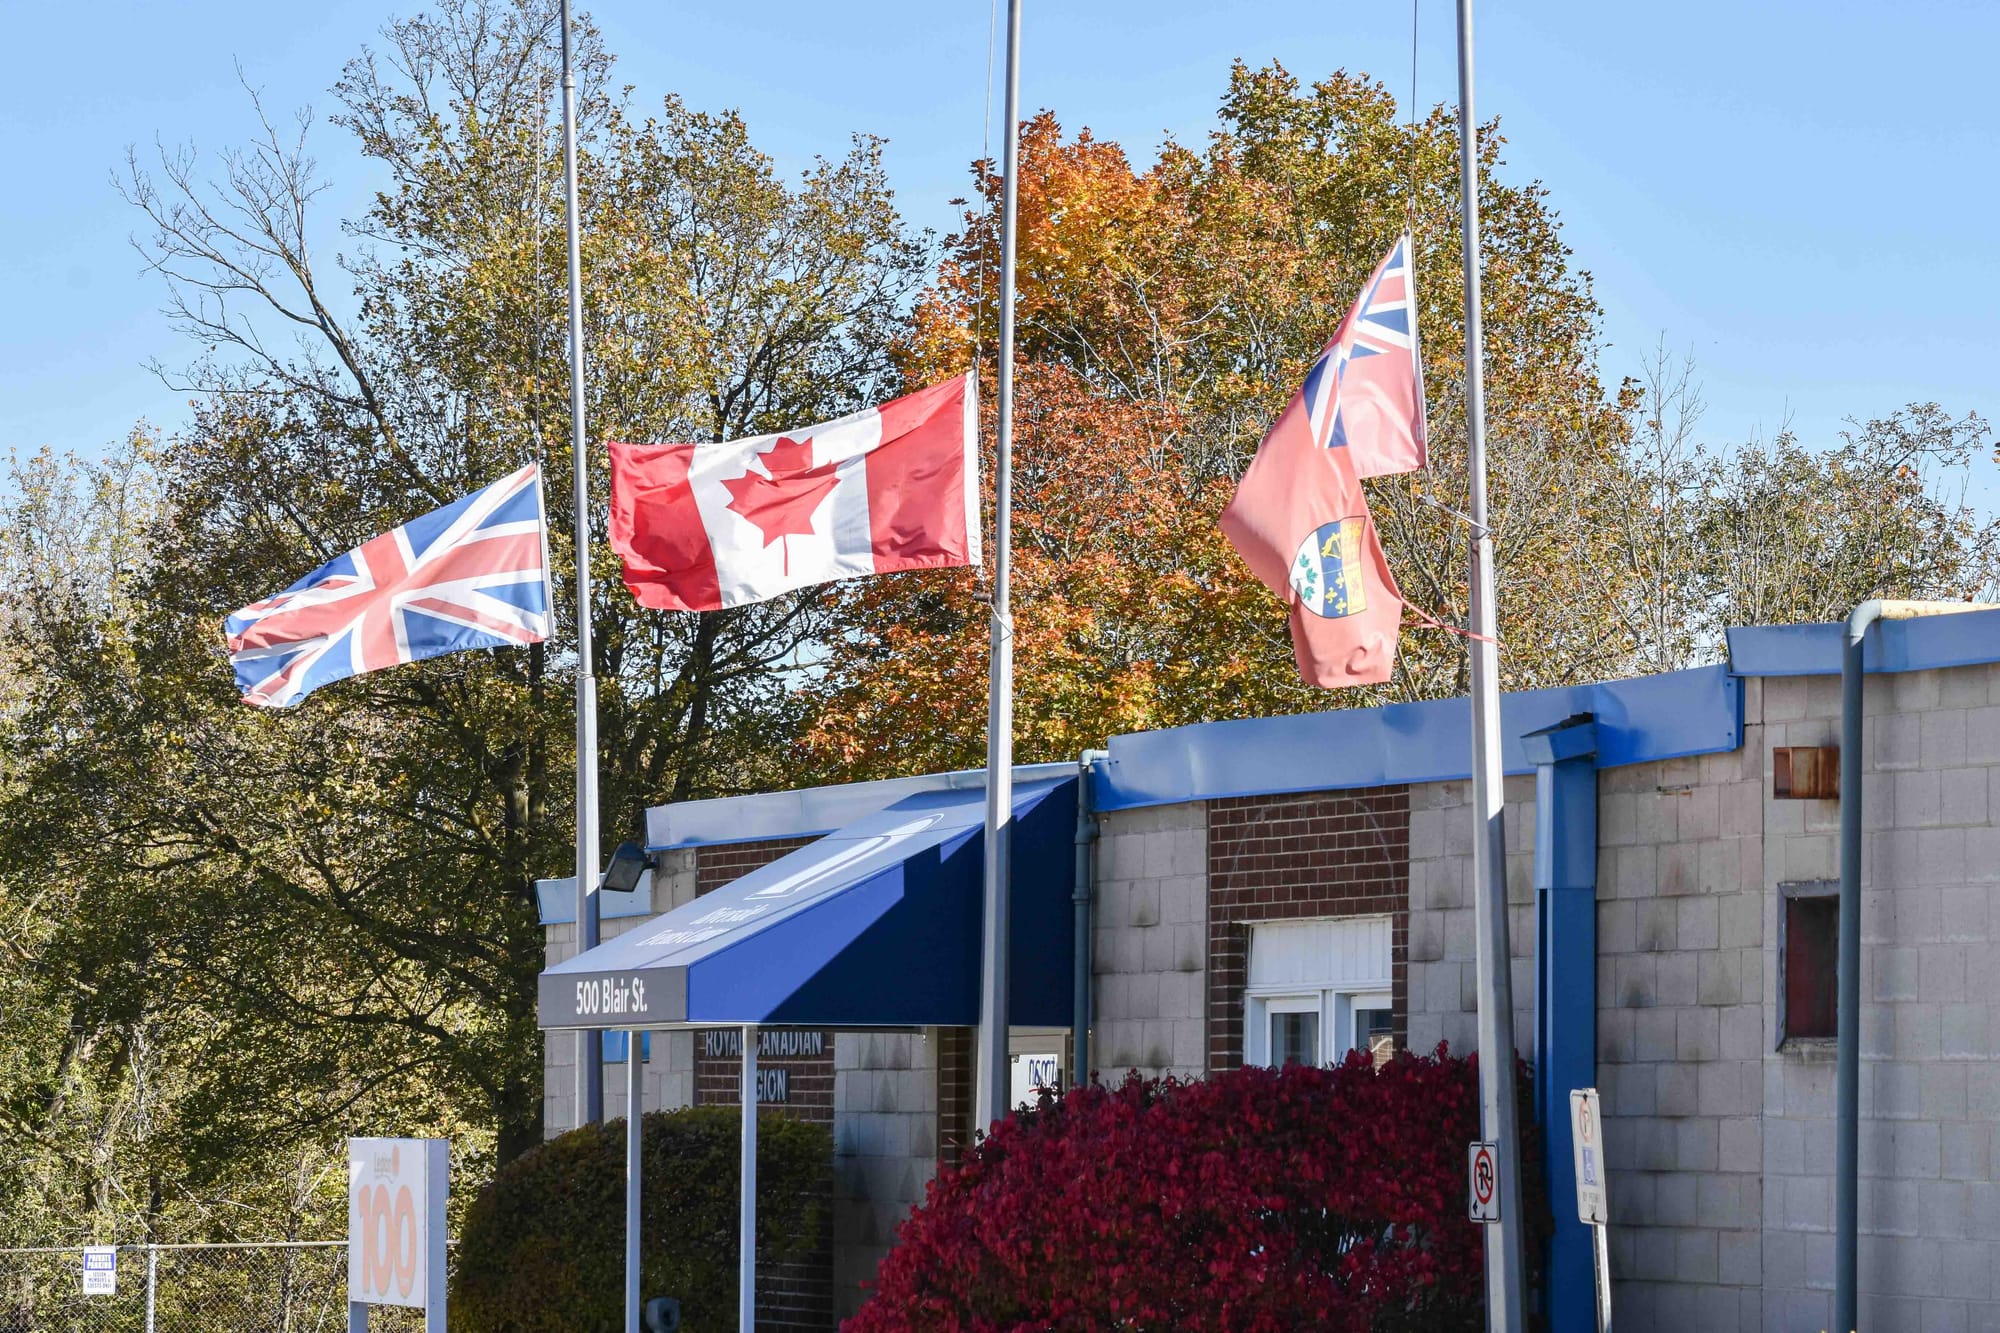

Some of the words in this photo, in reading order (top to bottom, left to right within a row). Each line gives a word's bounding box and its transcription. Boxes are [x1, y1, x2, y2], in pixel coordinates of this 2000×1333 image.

[576, 980, 599, 1015] 500
[602, 977, 630, 1013] Blair
[631, 977, 648, 1012] St.
[757, 1031, 821, 1056] ANADIAN
[358, 1183, 417, 1298] 100
